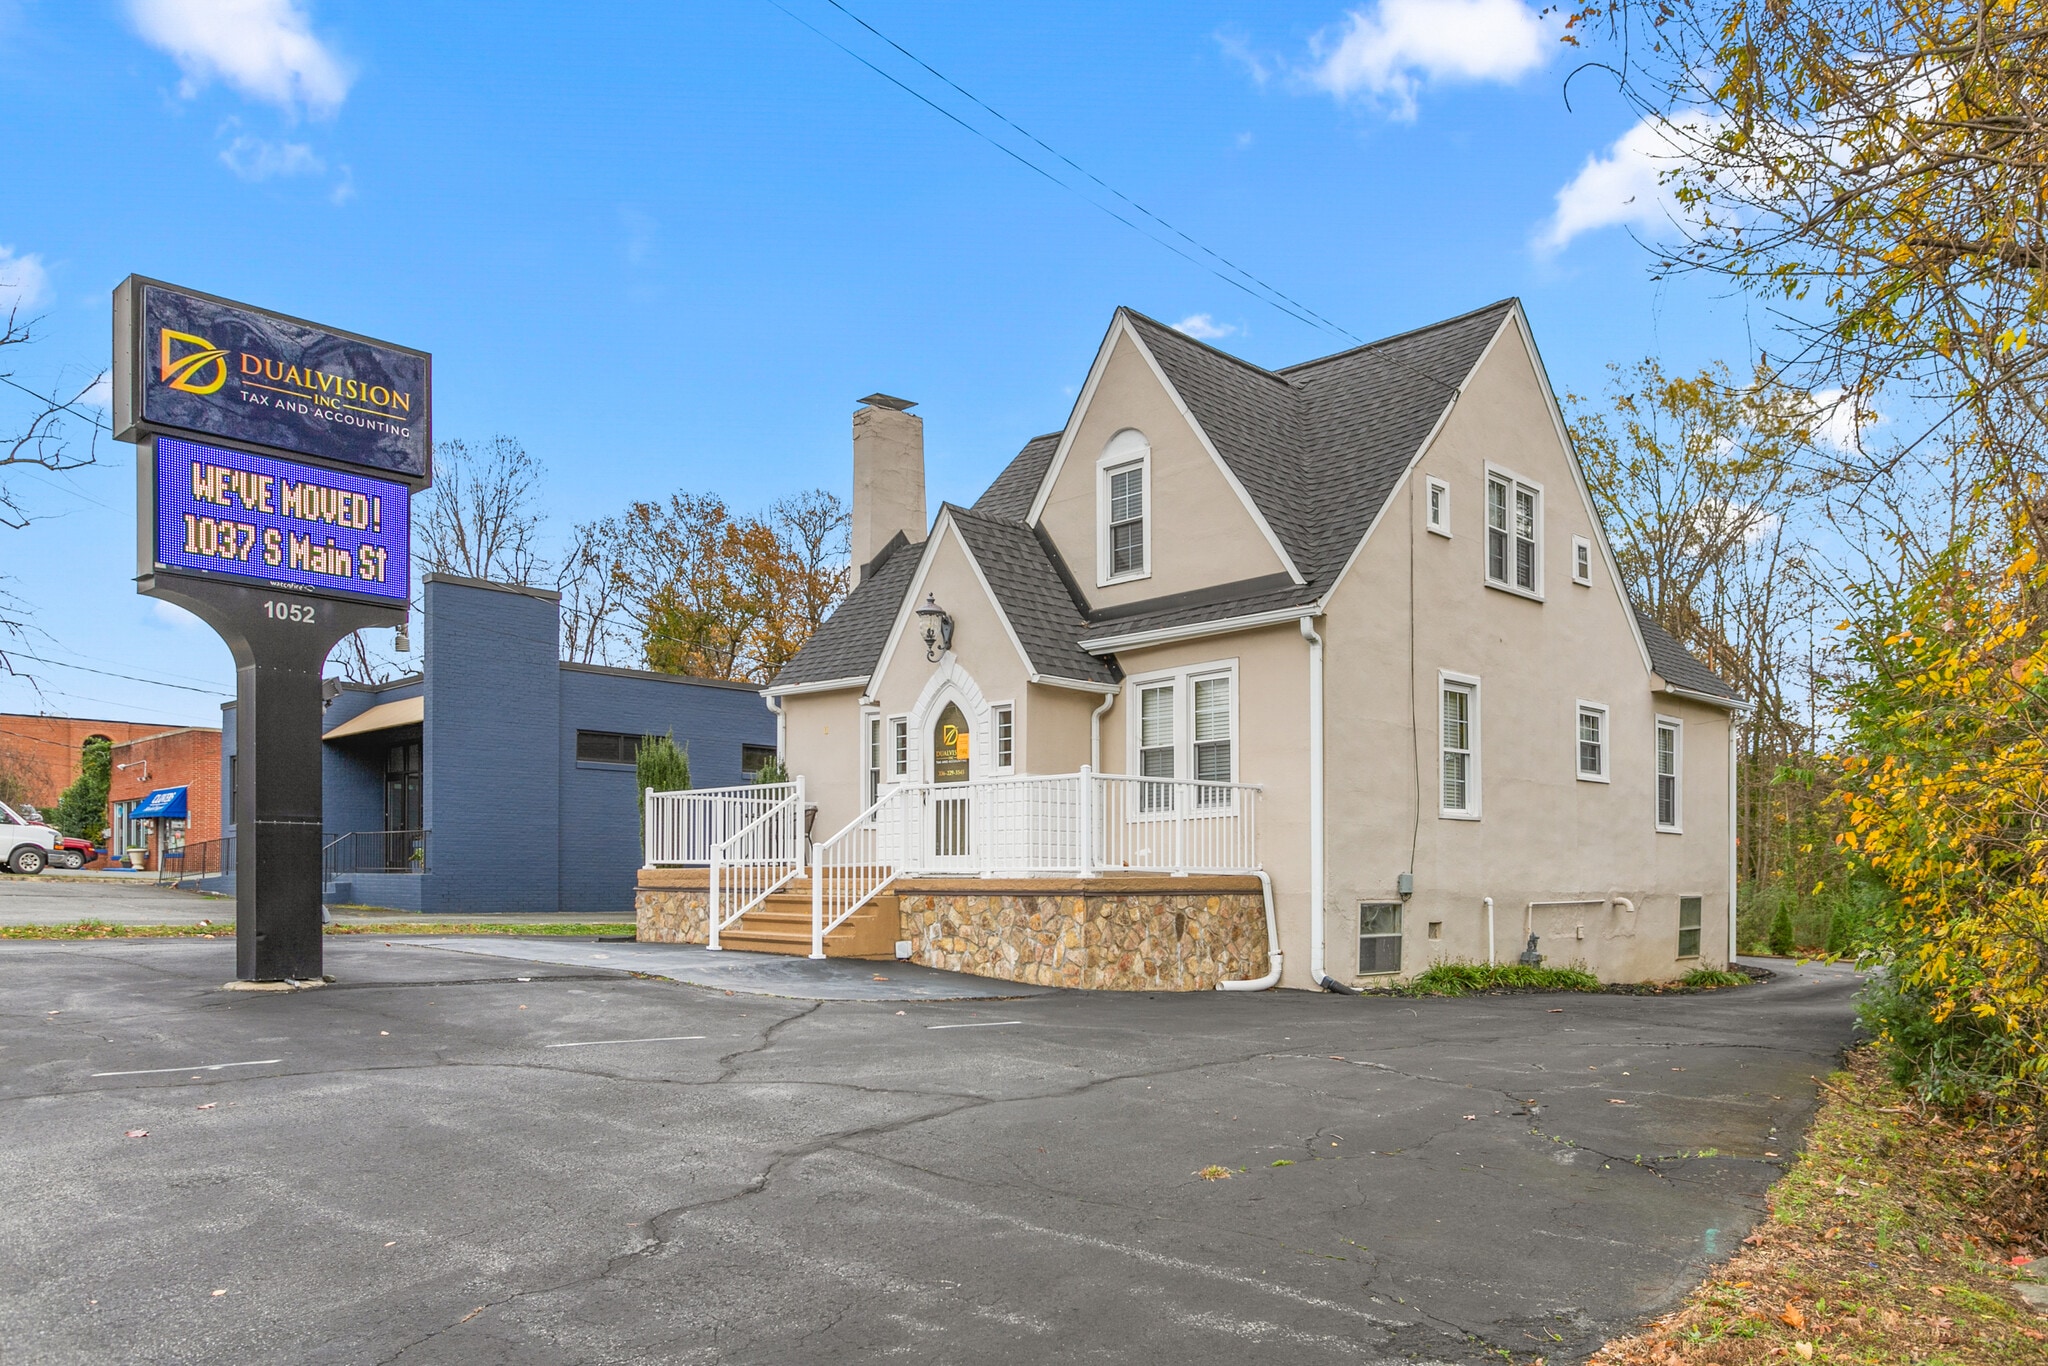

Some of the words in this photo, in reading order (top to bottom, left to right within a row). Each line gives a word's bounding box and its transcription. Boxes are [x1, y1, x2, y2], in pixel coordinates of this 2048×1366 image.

[240, 353, 410, 411] DUALVISION
[314, 394, 341, 410] INC
[240, 391, 269, 406] TAX
[275, 399, 308, 415] AND
[314, 408, 410, 438] ACCOUNTING
[191, 461, 274, 514] WE'VE
[281, 478, 381, 533] MOVED!
[183, 513, 257, 562] 1037
[263, 527, 283, 567] S
[288, 530, 353, 579] Main
[357, 544, 388, 583] St
[264, 600, 316, 624] 1052
